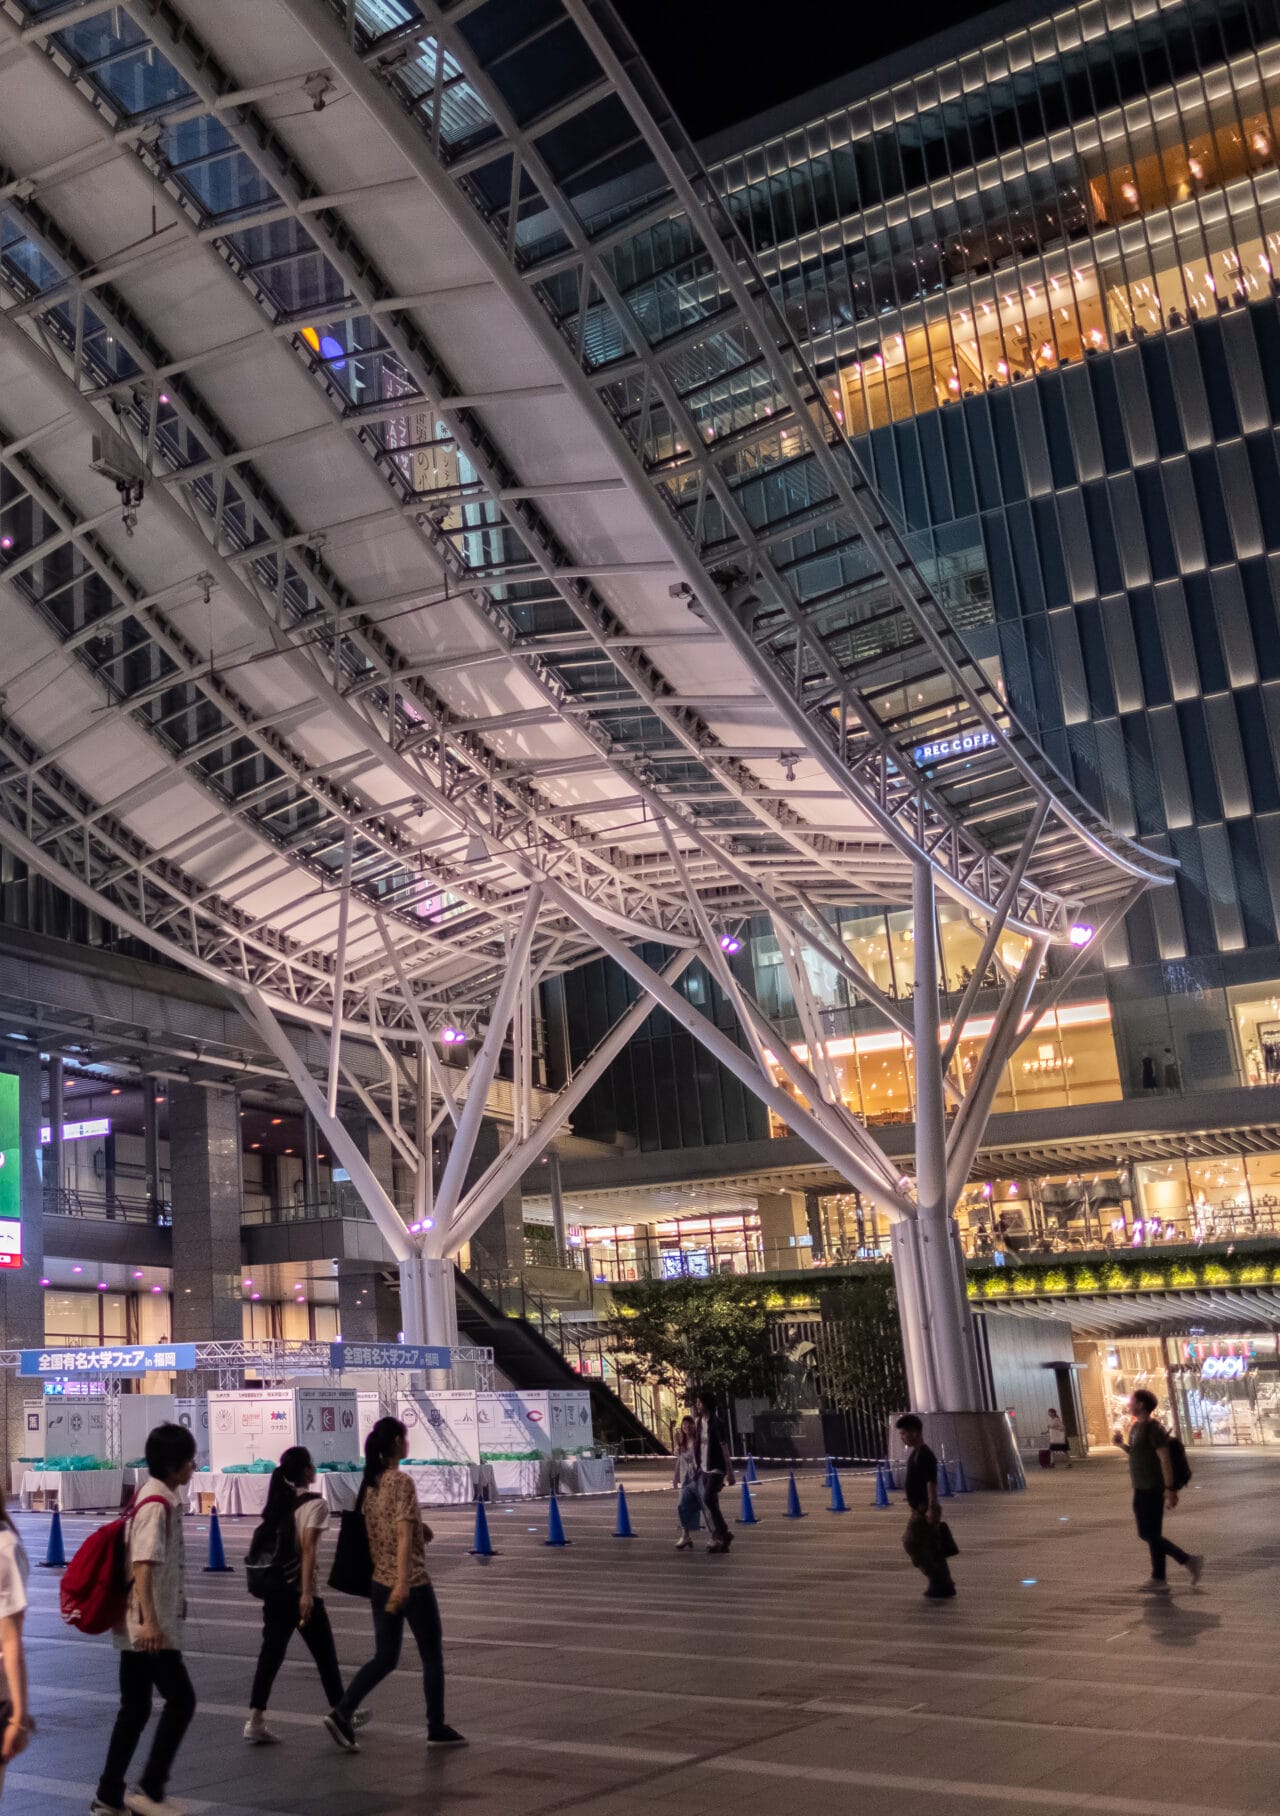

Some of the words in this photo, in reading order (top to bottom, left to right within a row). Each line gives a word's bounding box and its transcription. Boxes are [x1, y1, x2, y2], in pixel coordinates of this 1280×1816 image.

[38, 1350, 144, 1371] 全国有名大学フェア
[145, 1357, 152, 1366] in
[154, 1352, 176, 1367] 福岡
[343, 1347, 419, 1365] 全国有名大学フェア
